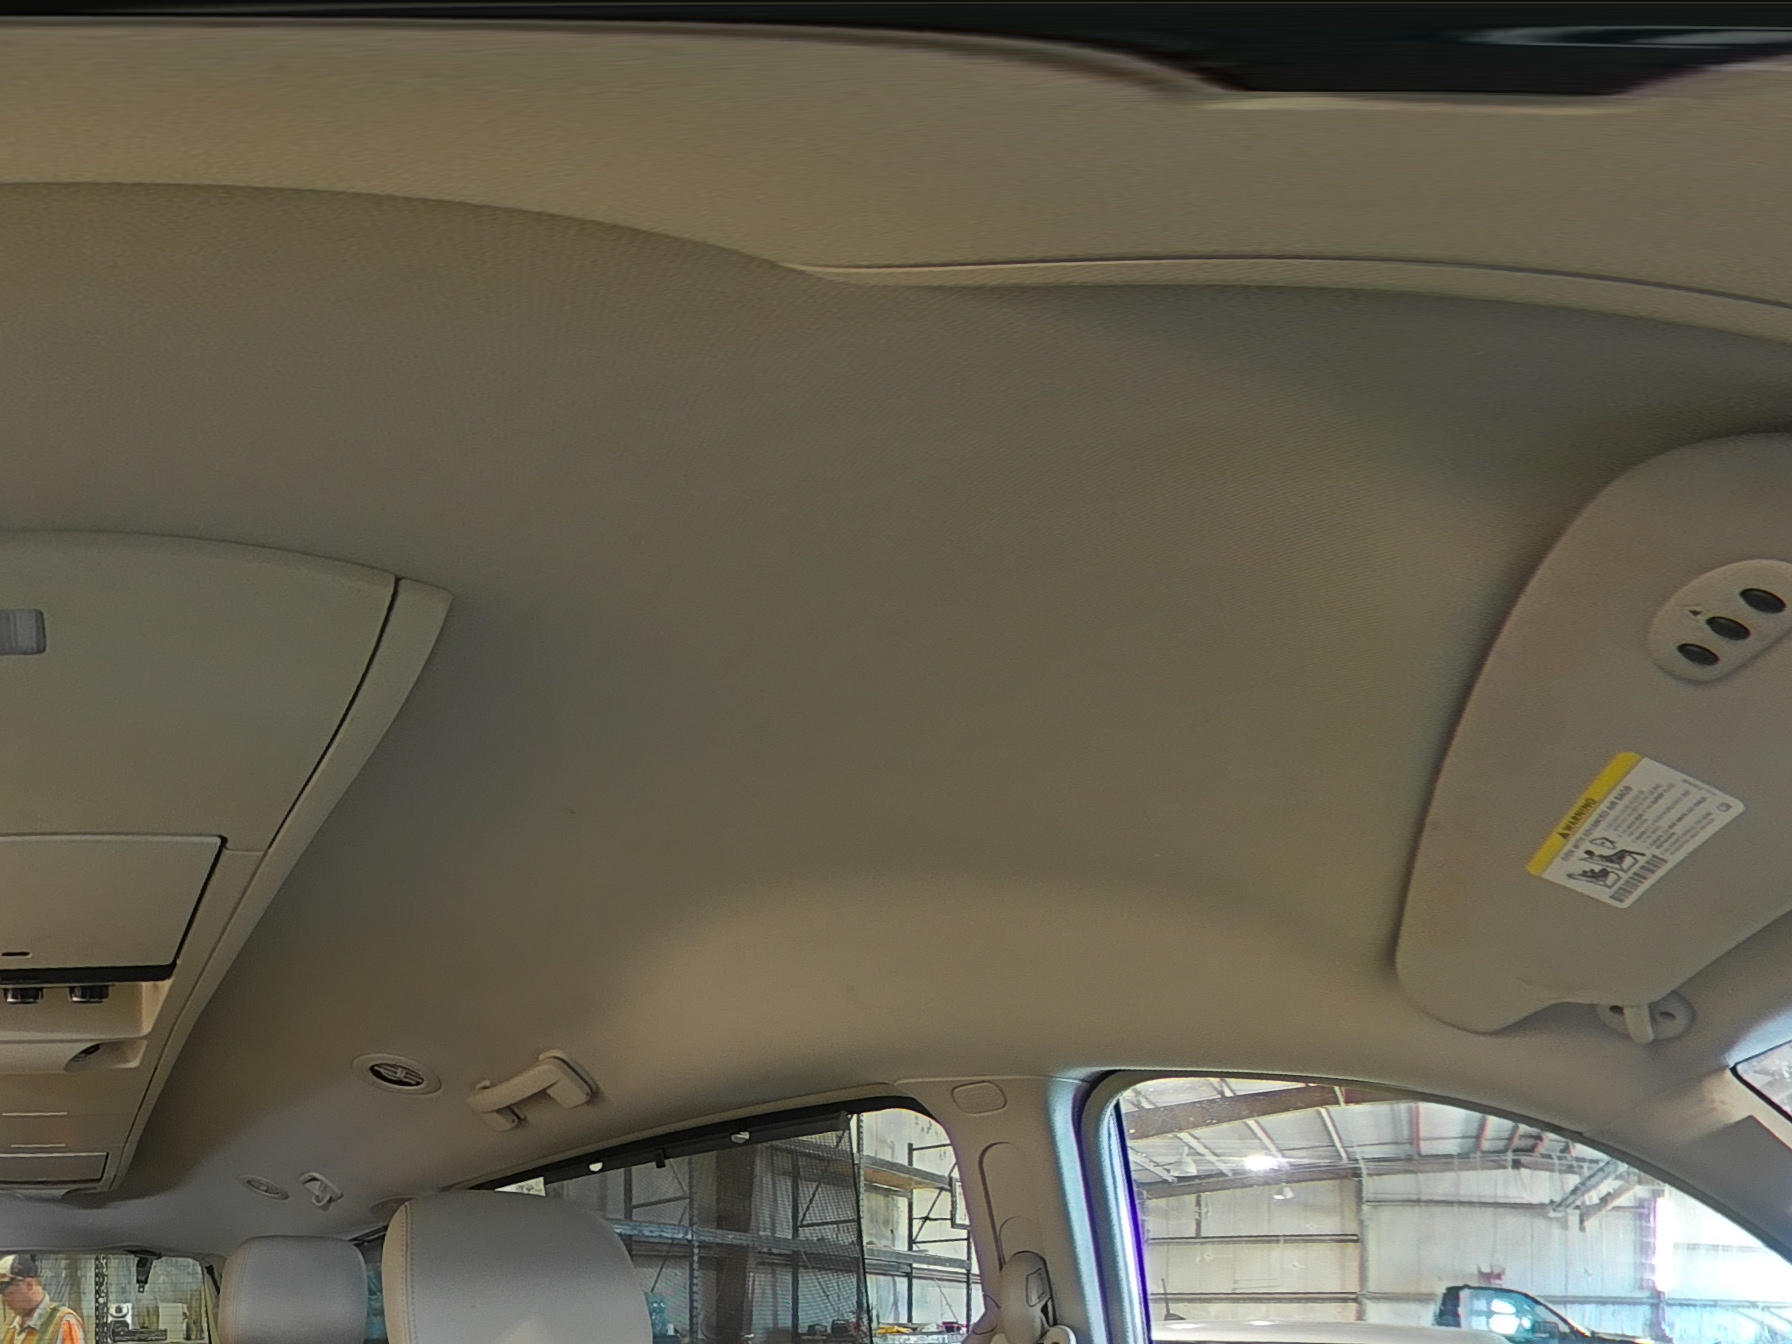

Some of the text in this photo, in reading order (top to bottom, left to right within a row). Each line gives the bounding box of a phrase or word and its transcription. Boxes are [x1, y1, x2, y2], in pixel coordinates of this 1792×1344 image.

[1564, 797, 1599, 833] WARNING
[1580, 808, 1612, 838] ADVANCED
[1603, 798, 1620, 812] AIR
